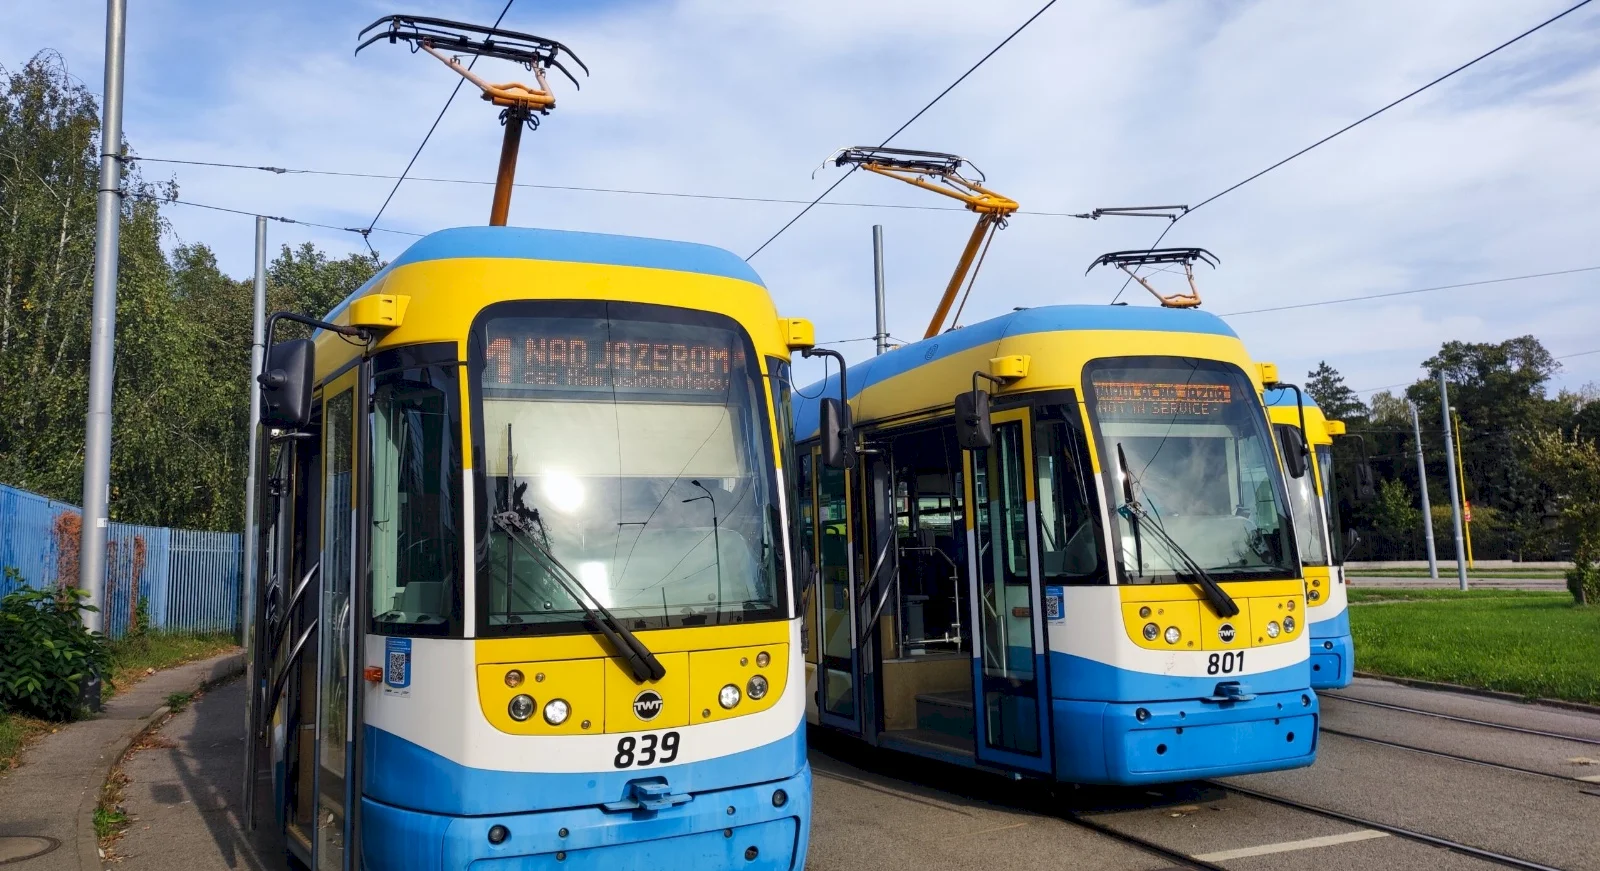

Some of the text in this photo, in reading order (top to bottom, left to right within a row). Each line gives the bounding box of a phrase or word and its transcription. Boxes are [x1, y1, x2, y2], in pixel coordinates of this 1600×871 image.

[487, 338, 511, 384] 1
[526, 338, 728, 374] NAD JAZEROM
[1098, 401, 1126, 413] NOT
[1133, 402, 1145, 414] IN
[1152, 402, 1210, 415] SERVICE
[1207, 651, 1244, 675] 801
[614, 731, 680, 769] 839
